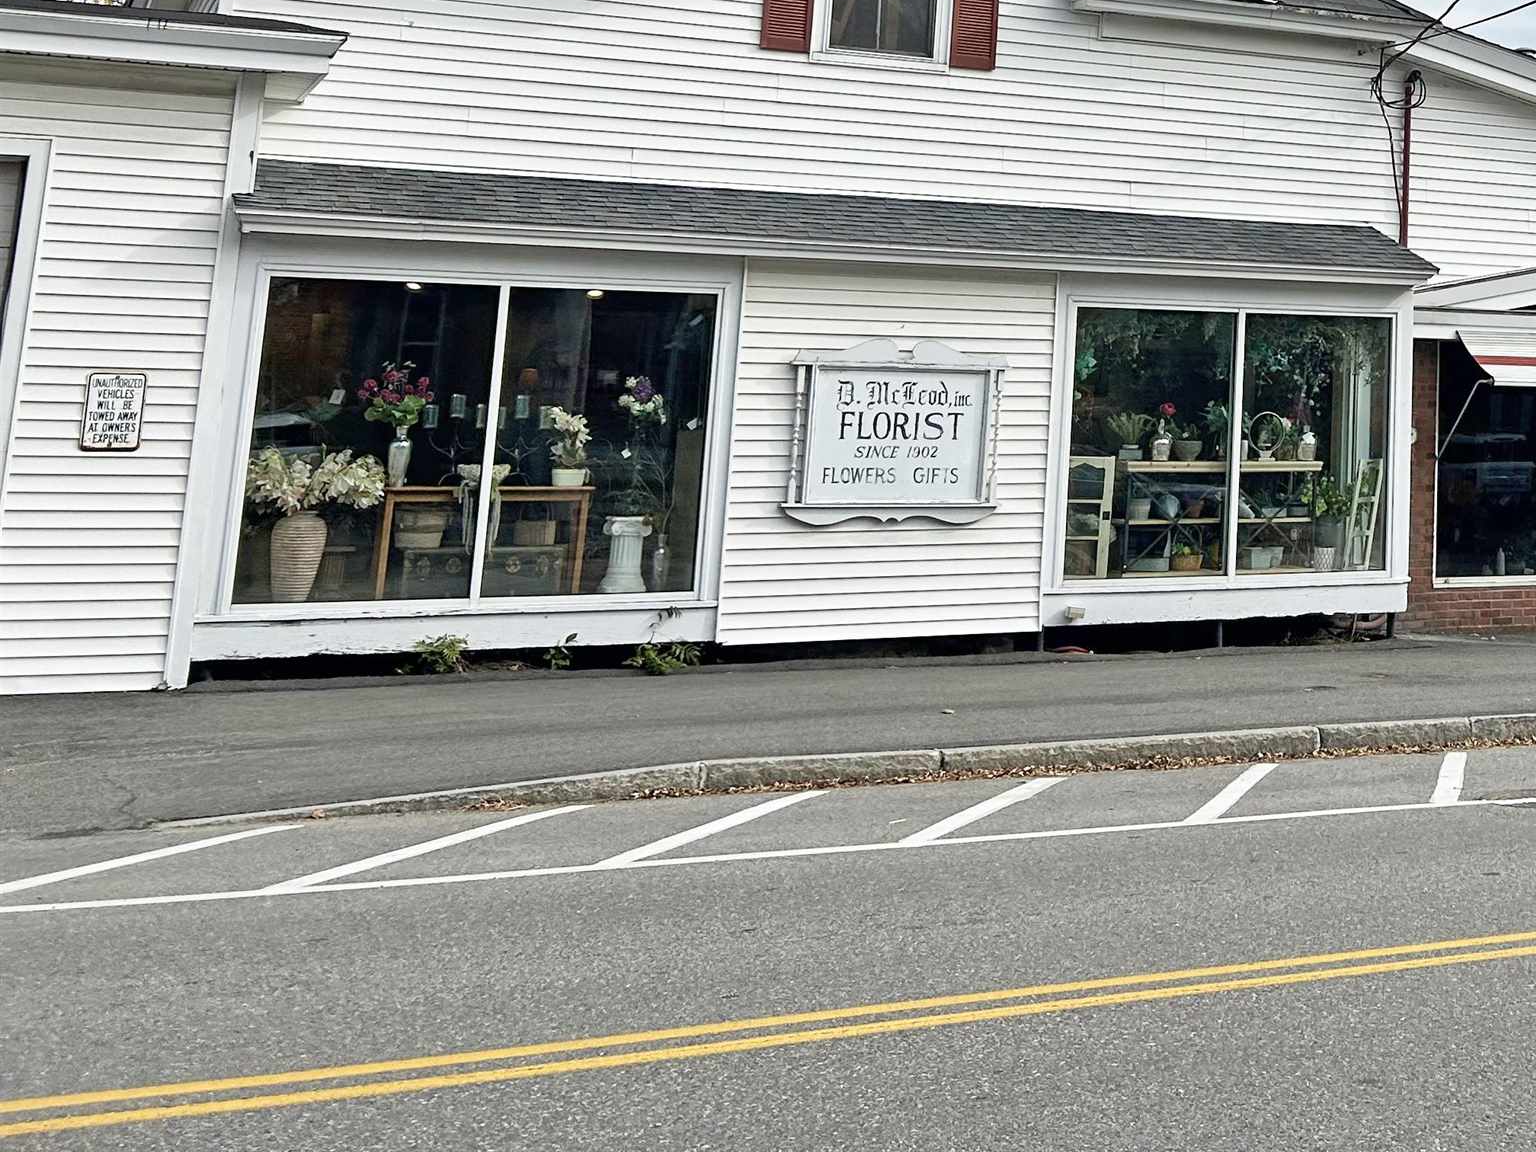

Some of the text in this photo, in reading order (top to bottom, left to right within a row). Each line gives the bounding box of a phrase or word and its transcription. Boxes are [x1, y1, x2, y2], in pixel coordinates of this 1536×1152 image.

[92, 378, 143, 388] UNAUTHORIZED
[98, 389, 135, 399] VEHICLES
[97, 400, 133, 410] WILL BE
[88, 412, 138, 421] TOWED AWAY
[88, 423, 98, 432] AT
[839, 411, 964, 440] FLORIST
[92, 434, 129, 443] EXPENSE
[854, 445, 938, 459] SINCE 1902
[822, 467, 959, 484] FLOWERS GIFTS
